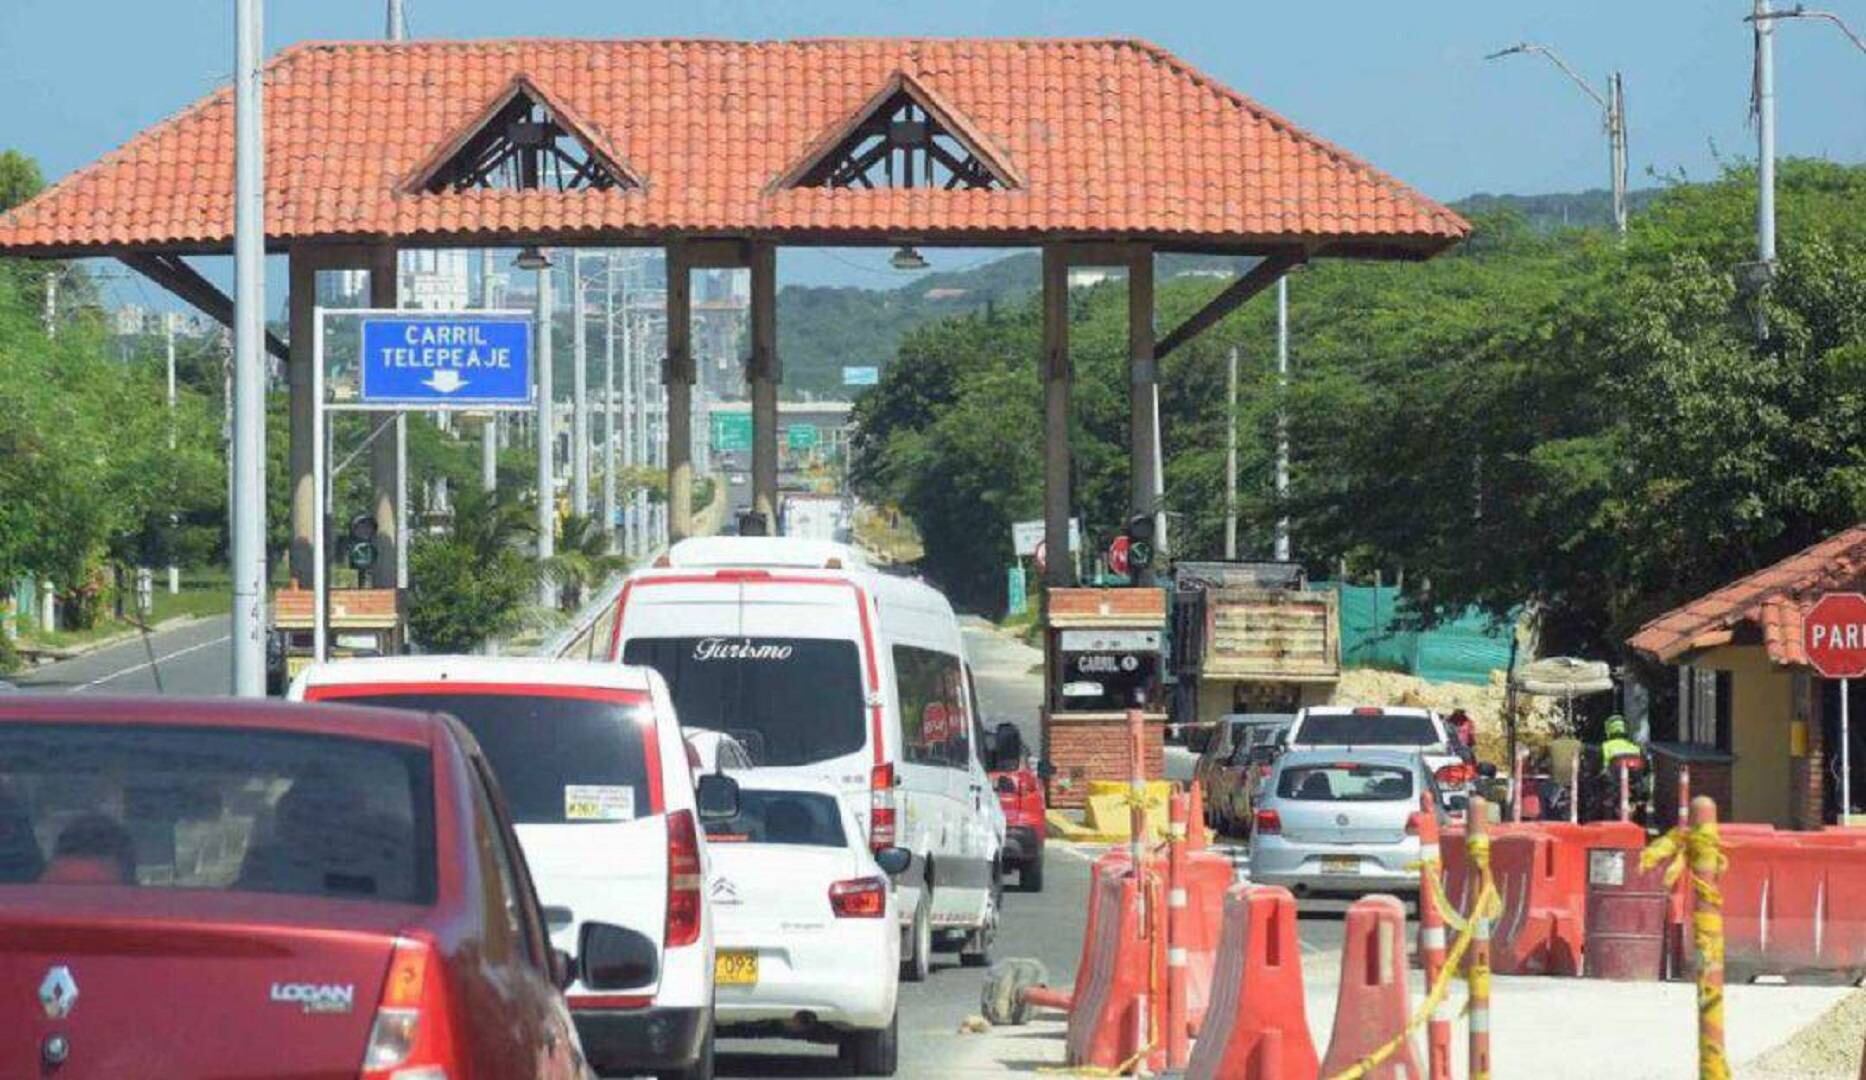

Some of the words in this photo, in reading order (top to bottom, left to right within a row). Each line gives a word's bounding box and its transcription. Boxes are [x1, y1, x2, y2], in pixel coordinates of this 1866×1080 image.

[405, 325, 488, 345] CARRIL
[381, 348, 511, 368] TELEPEAJE
[692, 637, 793, 660] Turismo
[270, 982, 354, 1002] LOGAN
